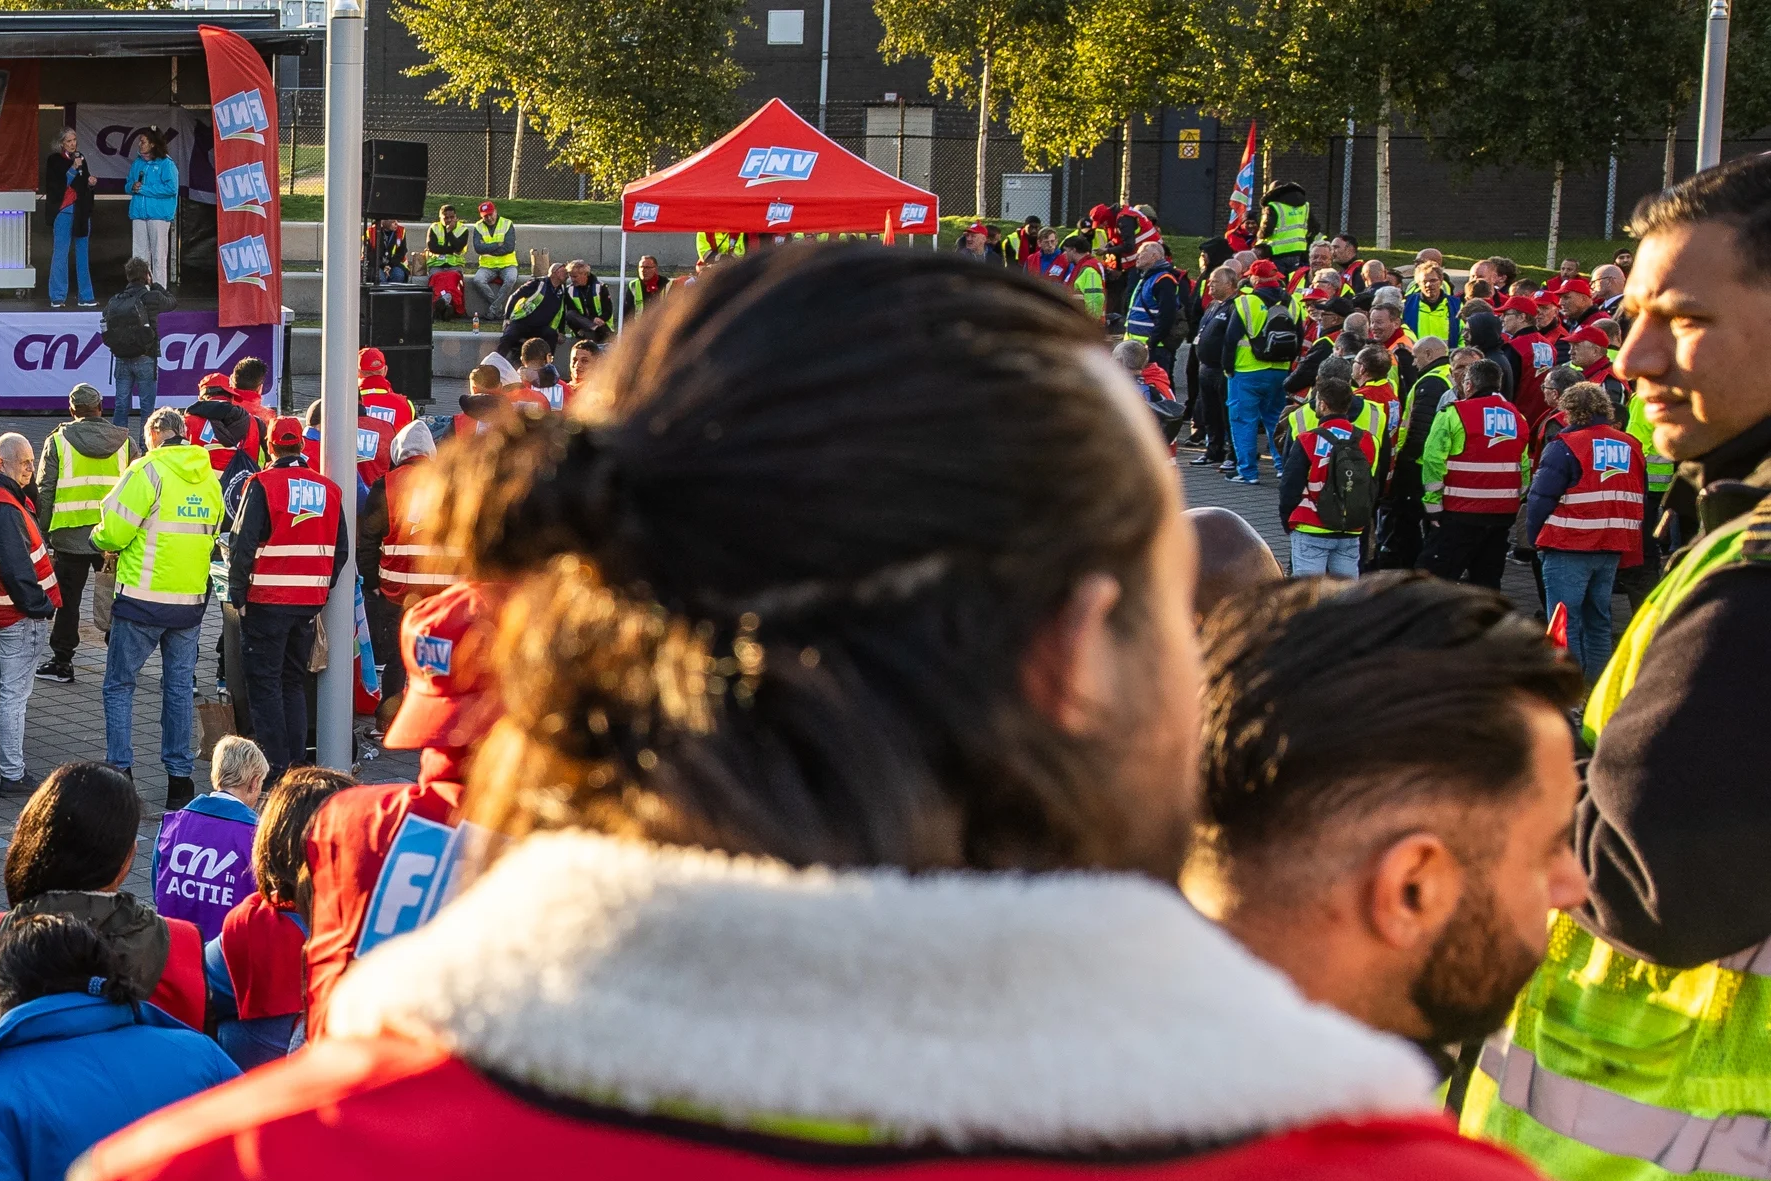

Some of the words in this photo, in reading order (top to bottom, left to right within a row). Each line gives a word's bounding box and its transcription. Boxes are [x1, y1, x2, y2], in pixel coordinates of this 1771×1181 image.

[748, 153, 811, 173] FNV
[634, 206, 657, 219] FNV
[768, 206, 792, 219] FNV
[902, 206, 926, 219] FNV
[1485, 413, 1516, 432] FNV
[1595, 445, 1628, 464] FNV
[291, 485, 325, 509] FNV
[177, 505, 209, 519] KLM
[226, 871, 235, 884] in
[166, 877, 234, 907] ACTIE
